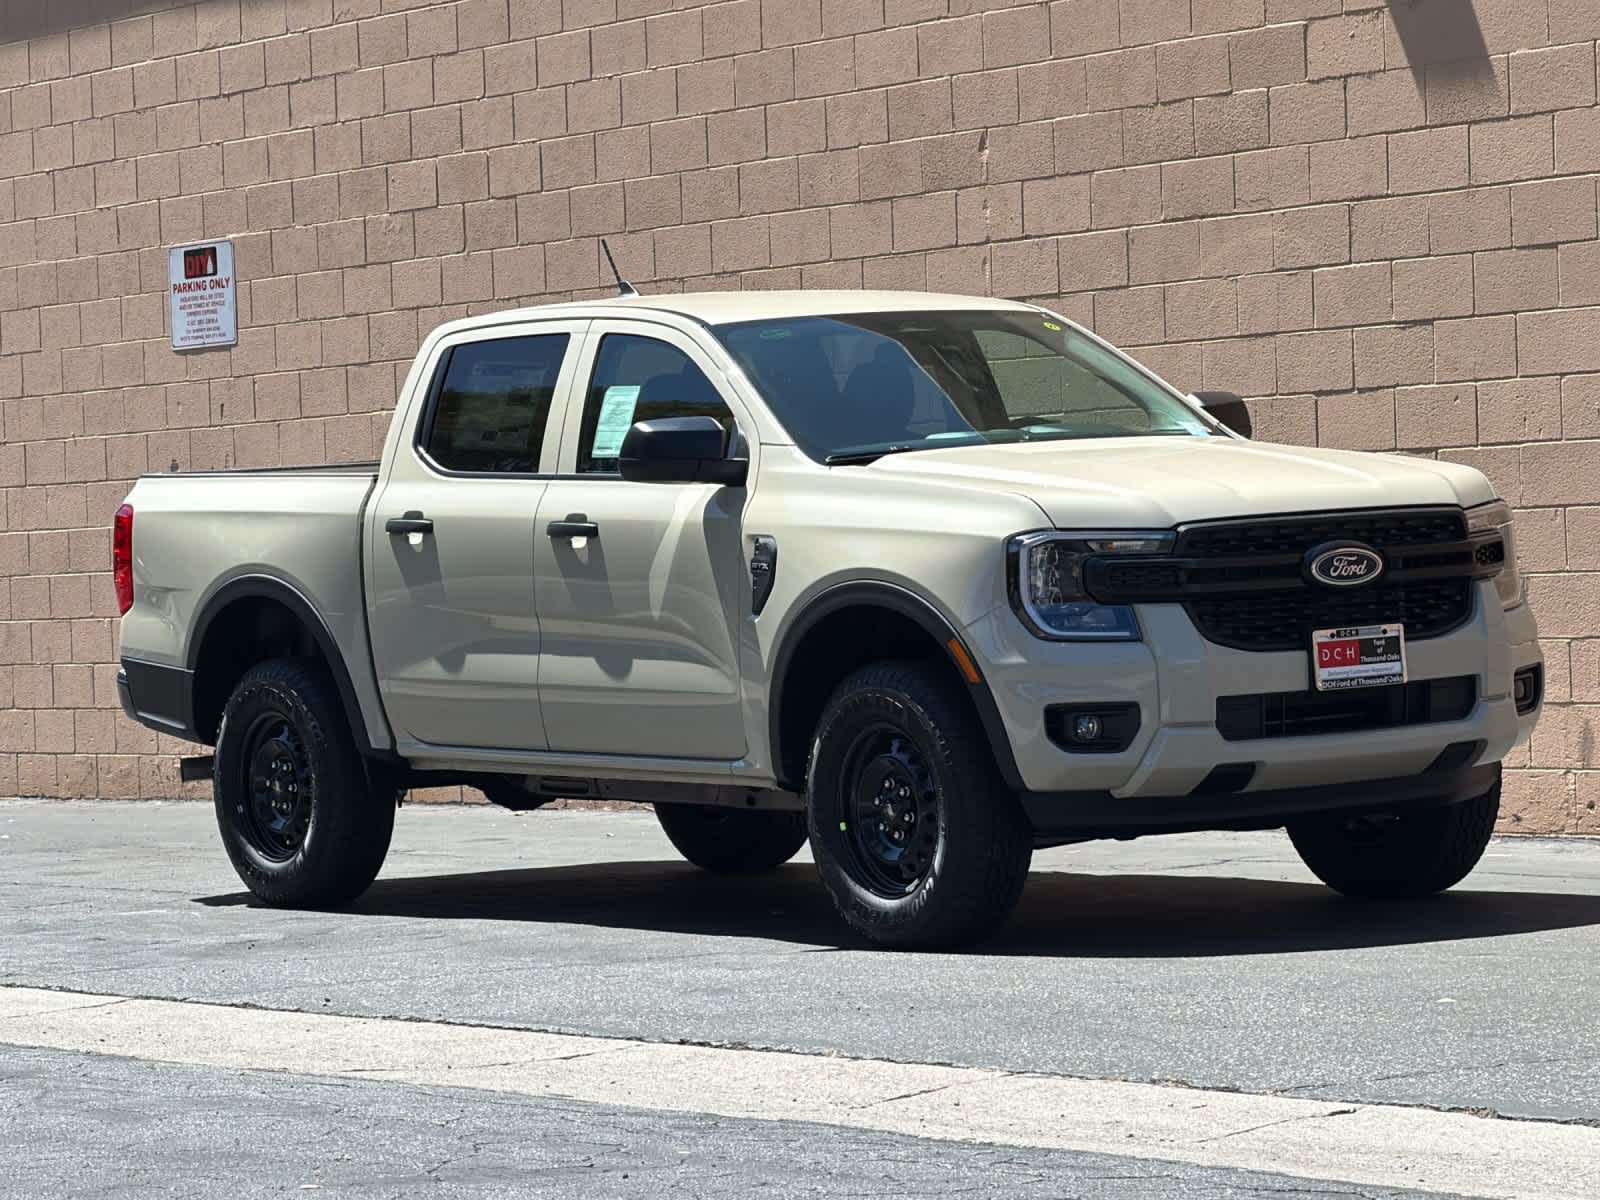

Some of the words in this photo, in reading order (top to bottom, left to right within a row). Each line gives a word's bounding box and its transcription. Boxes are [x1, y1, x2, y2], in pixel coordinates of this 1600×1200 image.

[173, 280, 207, 294] PARKING
[209, 277, 231, 290] ONLY
[1330, 555, 1368, 576] Ford
[1322, 647, 1355, 661] DCH
[1360, 654, 1386, 663] Thousand
[1387, 653, 1400, 661] Oaks
[1359, 677, 1387, 686] Thousand
[1388, 675, 1403, 683] Oaks
